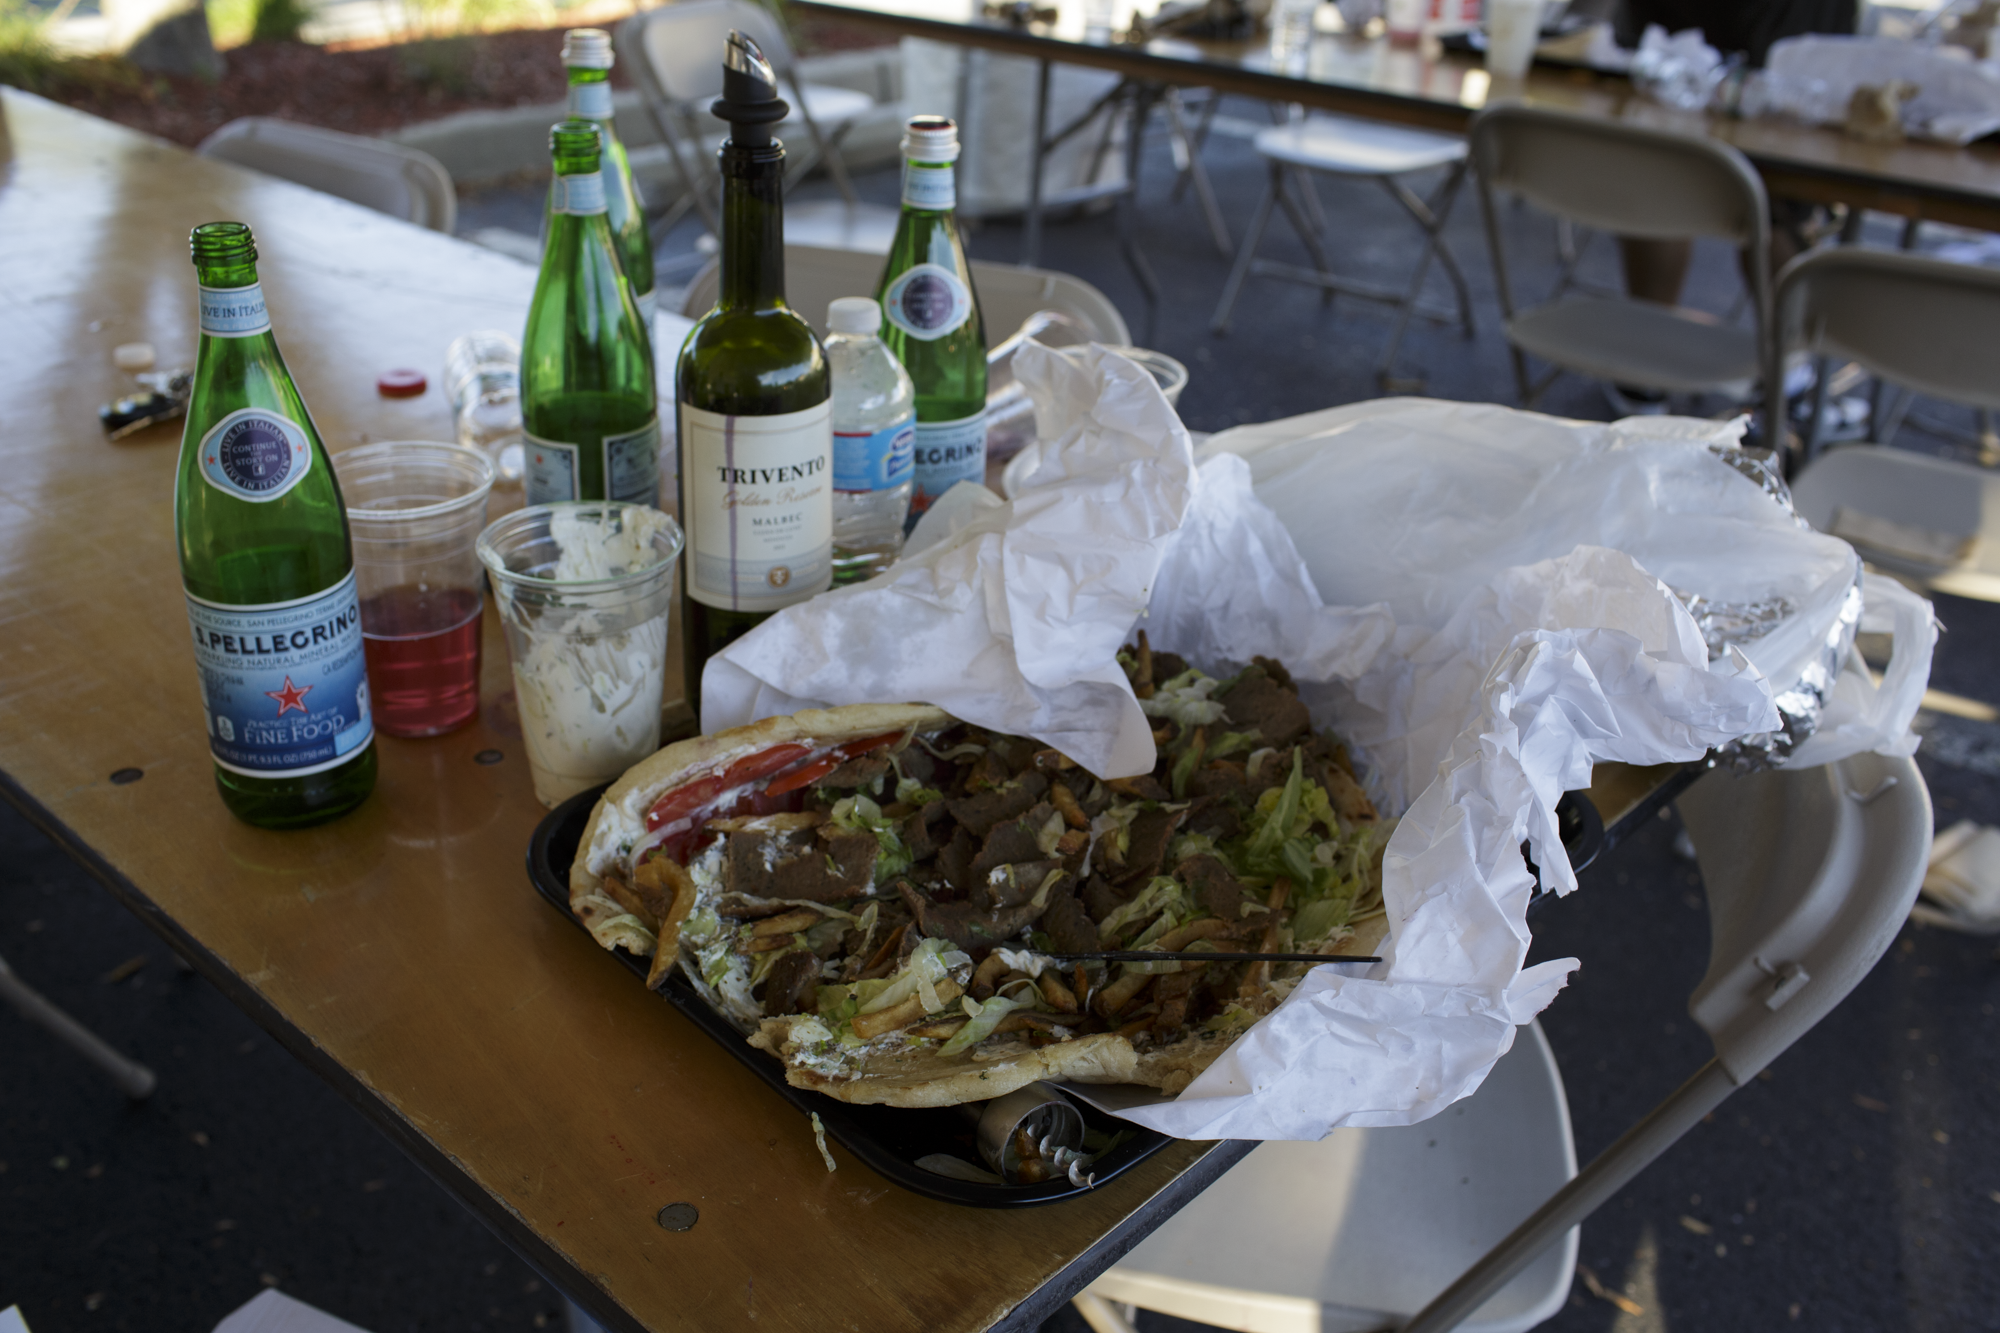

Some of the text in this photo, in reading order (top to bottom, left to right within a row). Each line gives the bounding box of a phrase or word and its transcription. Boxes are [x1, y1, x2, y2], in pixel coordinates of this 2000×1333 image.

[222, 307, 236, 318] IN
[235, 422, 247, 433] IN
[232, 440, 278, 454] CONTINUE
[235, 453, 279, 467] STORY ON
[717, 454, 826, 485] TRIVENTO
[242, 481, 255, 490] IN
[752, 511, 803, 526] MALBEC
[247, 619, 266, 628] SAN
[266, 610, 314, 627] PELLEGRINO
[315, 603, 336, 617] TERME
[246, 655, 296, 667] NATURAL
[243, 727, 289, 745] FINE
[291, 714, 345, 743] FOOD
[247, 718, 288, 729] PRACTICE
